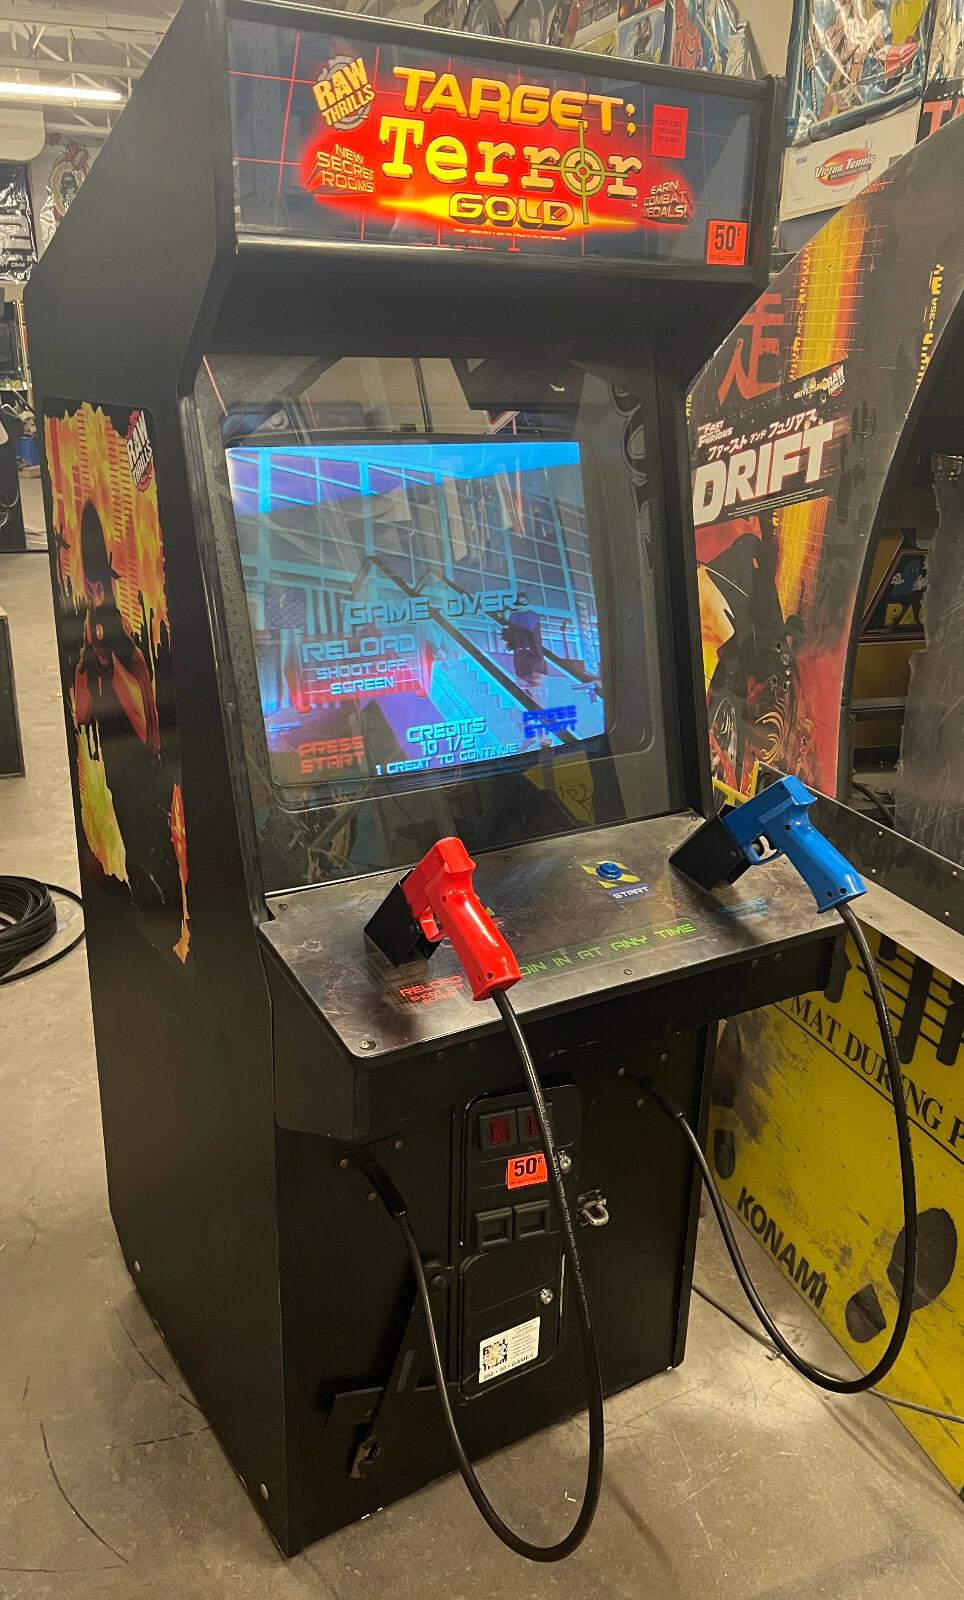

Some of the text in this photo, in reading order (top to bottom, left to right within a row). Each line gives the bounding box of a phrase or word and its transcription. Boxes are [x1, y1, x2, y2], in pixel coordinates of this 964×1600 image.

[313, 57, 369, 111] RAW
[322, 83, 375, 126] THRILLS
[393, 66, 636, 136] TARGET:
[316, 151, 375, 181] SECRET
[335, 143, 364, 165] NEW
[379, 115, 643, 199] Terror
[814, 164, 843, 179] Virtua
[845, 154, 876, 170] Tennis
[643, 190, 687, 206] COMBAT
[650, 179, 679, 195] EARN
[449, 192, 574, 231] GOLD
[827, 364, 845, 391] RAW
[126, 410, 149, 471] RAW
[698, 426, 734, 449] FURIOUS
[693, 420, 835, 526] DRIFT
[347, 589, 522, 626] GAME OVER
[884, 602, 924, 627] PA
[302, 632, 416, 663] RELOAD
[316, 658, 407, 681] SHOOT OFF
[330, 675, 395, 695] SCREEN
[406, 717, 487, 744] CREDITS
[300, 736, 364, 757] PRESS
[386, 756, 432, 776] CREDIT
[435, 752, 455, 766] TO
[458, 741, 519, 763] CONTINUE
[421, 735, 476, 757] 10 1/2
[300, 750, 365, 775] START
[612, 885, 650, 901] START
[519, 922, 698, 978] OIN IN AT ANY TIME
[400, 975, 463, 997] RELOAD
[789, 994, 842, 1046] MAT
[842, 1030, 945, 1131] DURNG
[737, 1186, 828, 1310] KONAMI
